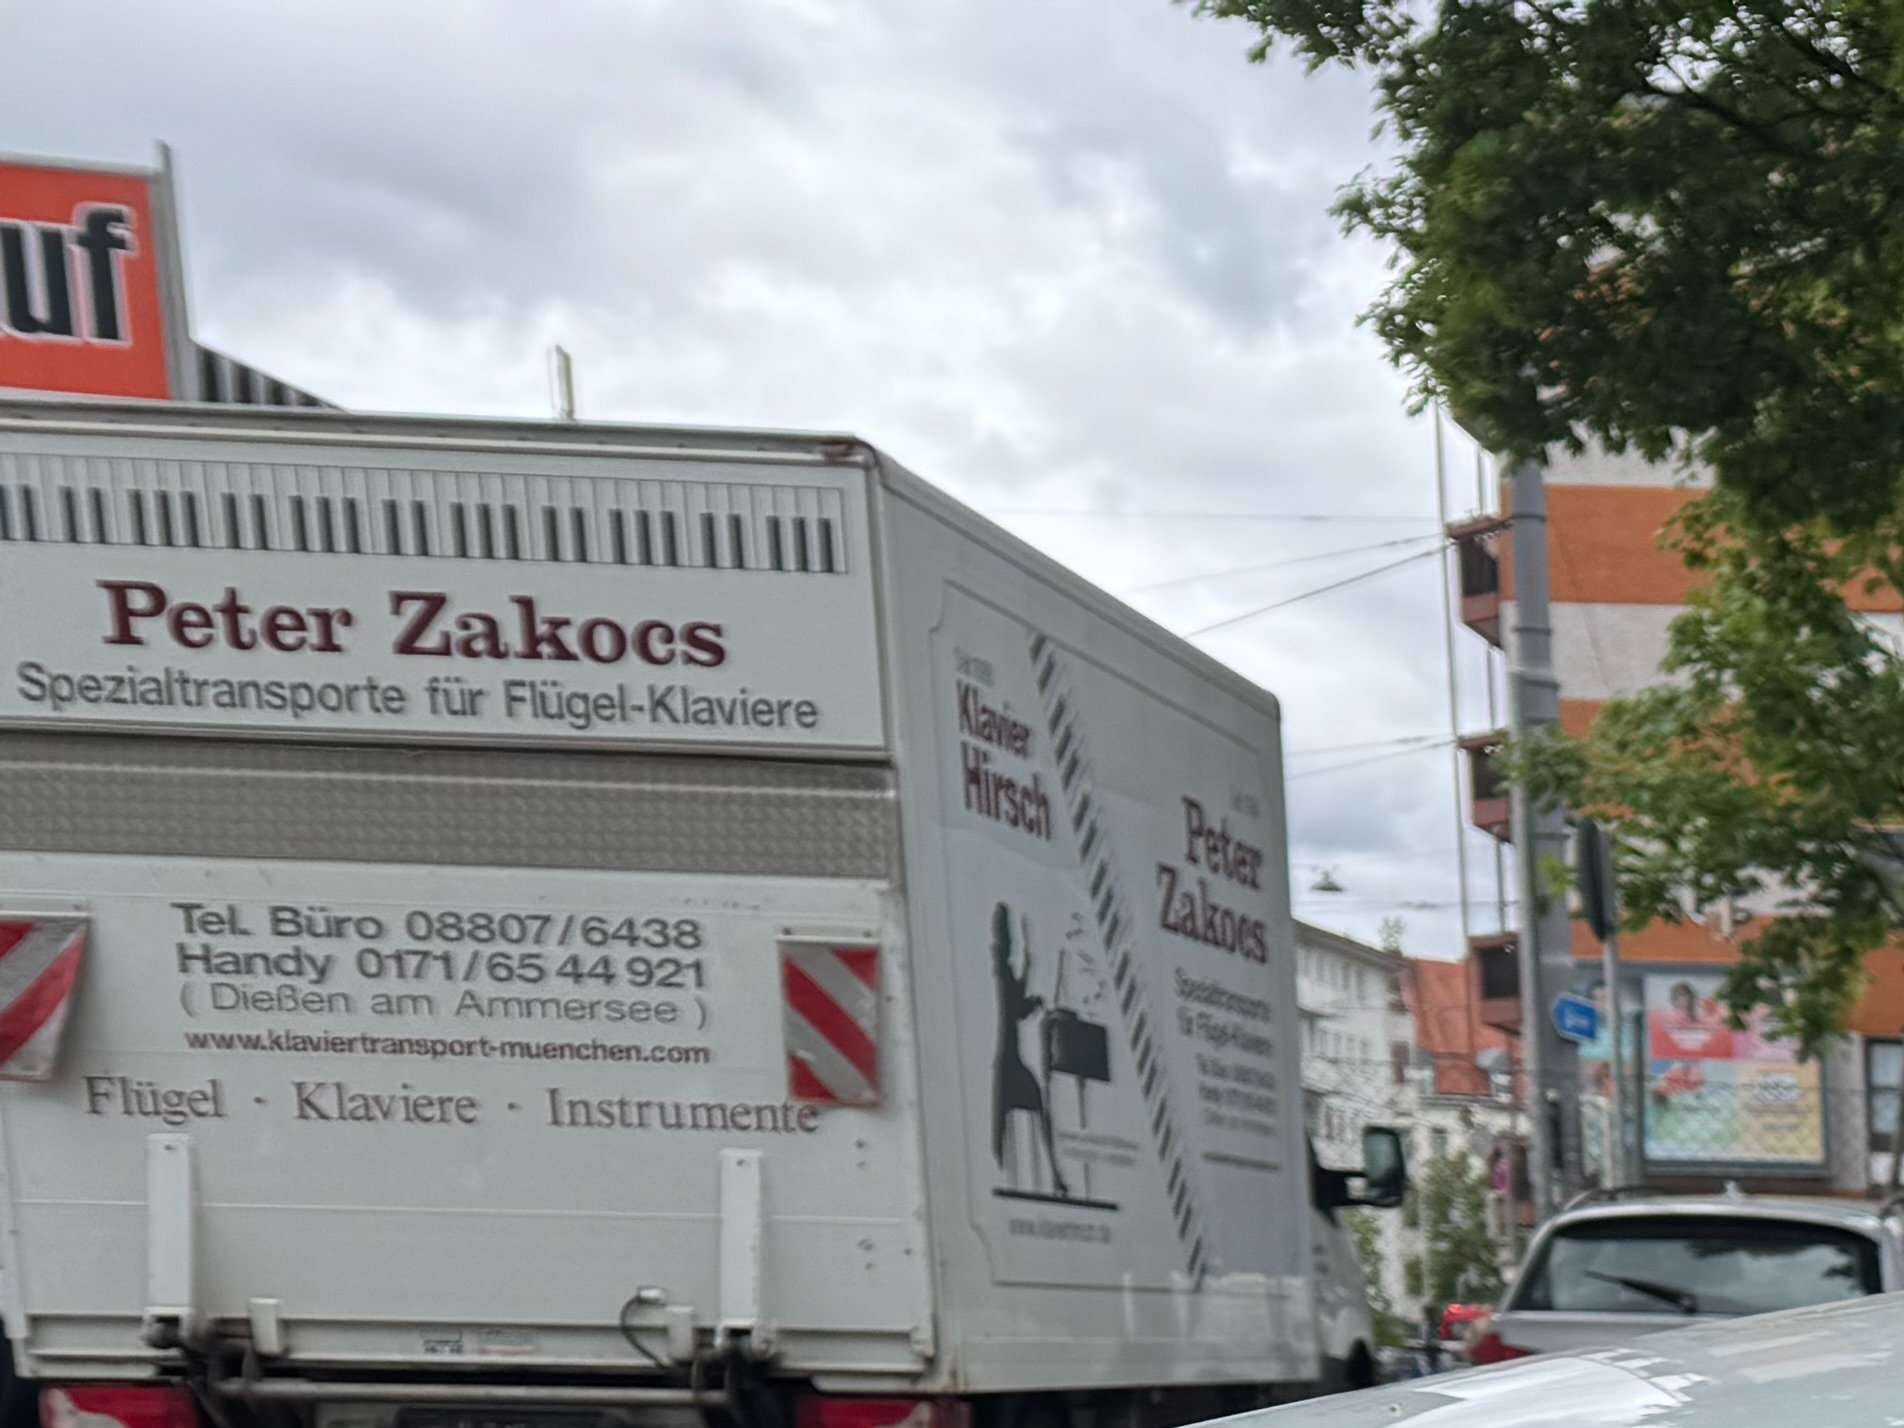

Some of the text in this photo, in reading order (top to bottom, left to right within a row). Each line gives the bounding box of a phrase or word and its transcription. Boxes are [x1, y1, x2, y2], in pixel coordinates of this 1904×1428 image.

[96, 579, 728, 668] Peter Zakocs
[16, 660, 820, 731] Spezialtransporte für Flügel-Klaviere
[956, 678, 1032, 760] Klavier
[960, 738, 1052, 842] Hirsch
[1181, 794, 1263, 890] Peter
[269, 904, 385, 941] Büro
[405, 909, 702, 951] 08807/6438
[1156, 861, 1270, 965] Zakocs
[176, 943, 336, 985] Handy
[625, 955, 706, 989] 921
[371, 992, 435, 1017] am
[455, 988, 680, 1025] Ammersee
[184, 1028, 712, 1065] www.klaviertransport-muenchen.com
[83, 1074, 821, 1134] Flügel Klaviere Instrumente
